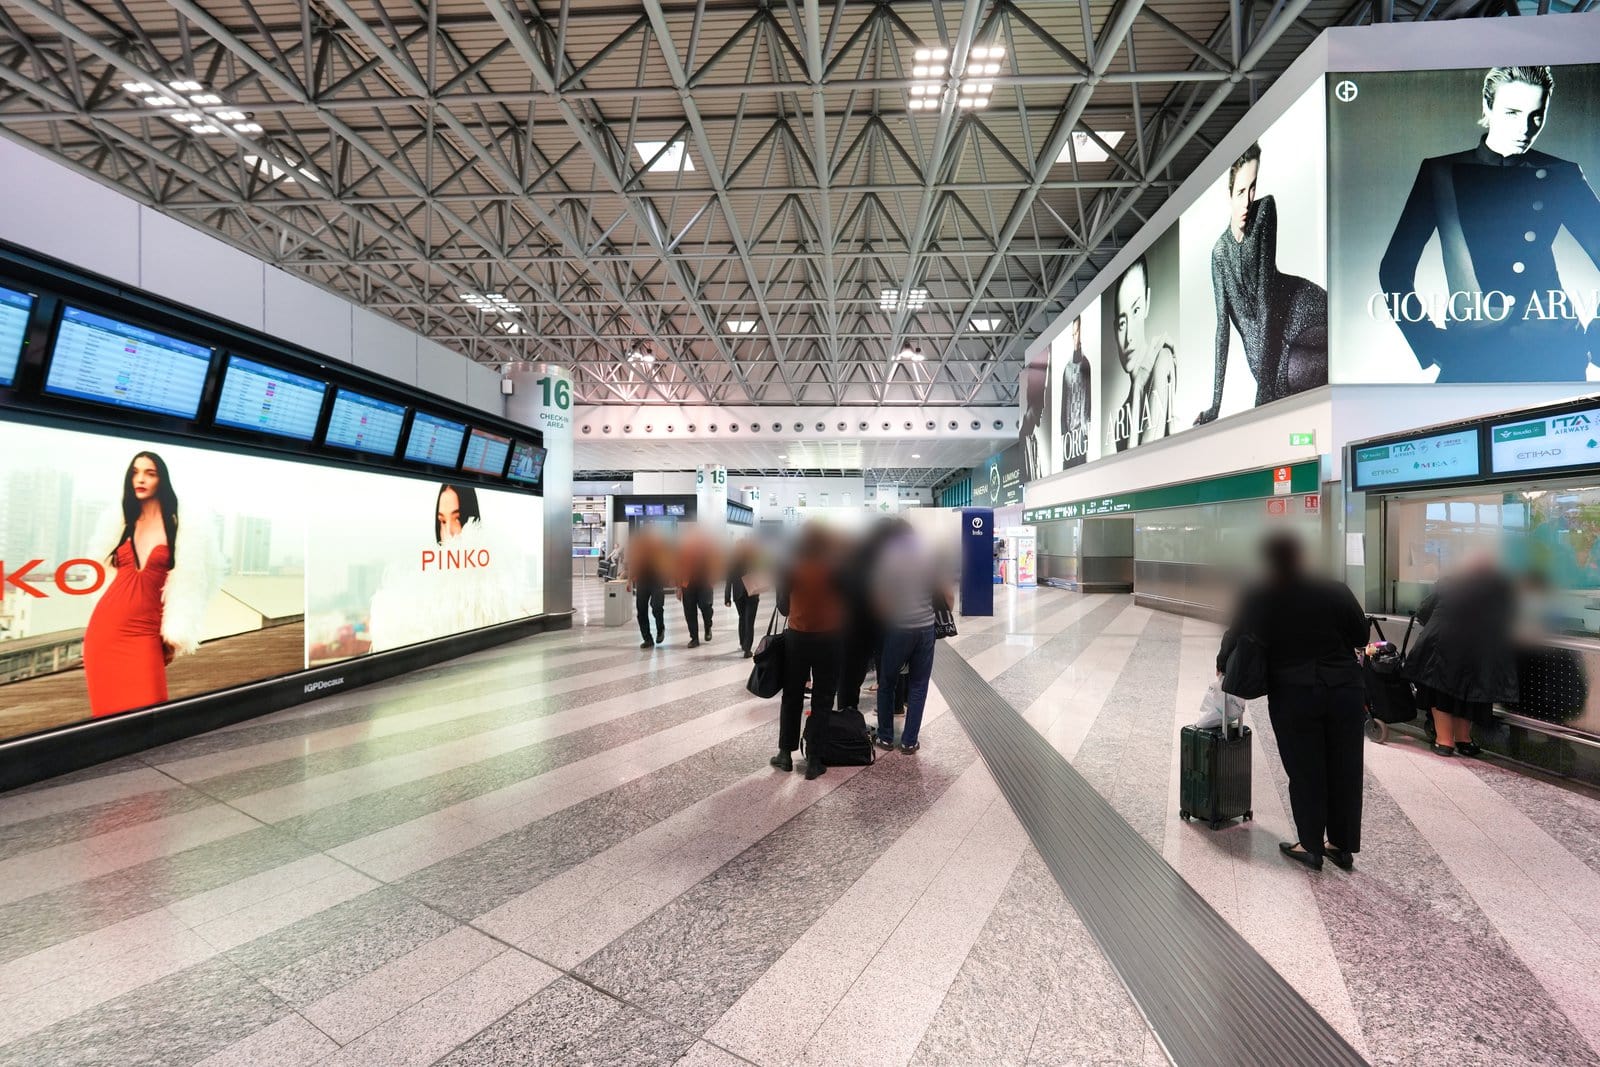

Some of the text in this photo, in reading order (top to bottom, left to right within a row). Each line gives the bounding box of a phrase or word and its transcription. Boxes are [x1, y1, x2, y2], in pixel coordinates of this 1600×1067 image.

[536, 376, 570, 410] 16
[547, 421, 565, 429] AREA
[1552, 414, 1591, 429] ITA
[1555, 425, 1590, 436] AIRWAYS
[1516, 448, 1562, 460] ETIHAD
[697, 470, 704, 484] 5
[710, 470, 725, 484] 15
[422, 549, 490, 571] PINKO
[303, 677, 344, 693] IGPDecaux
